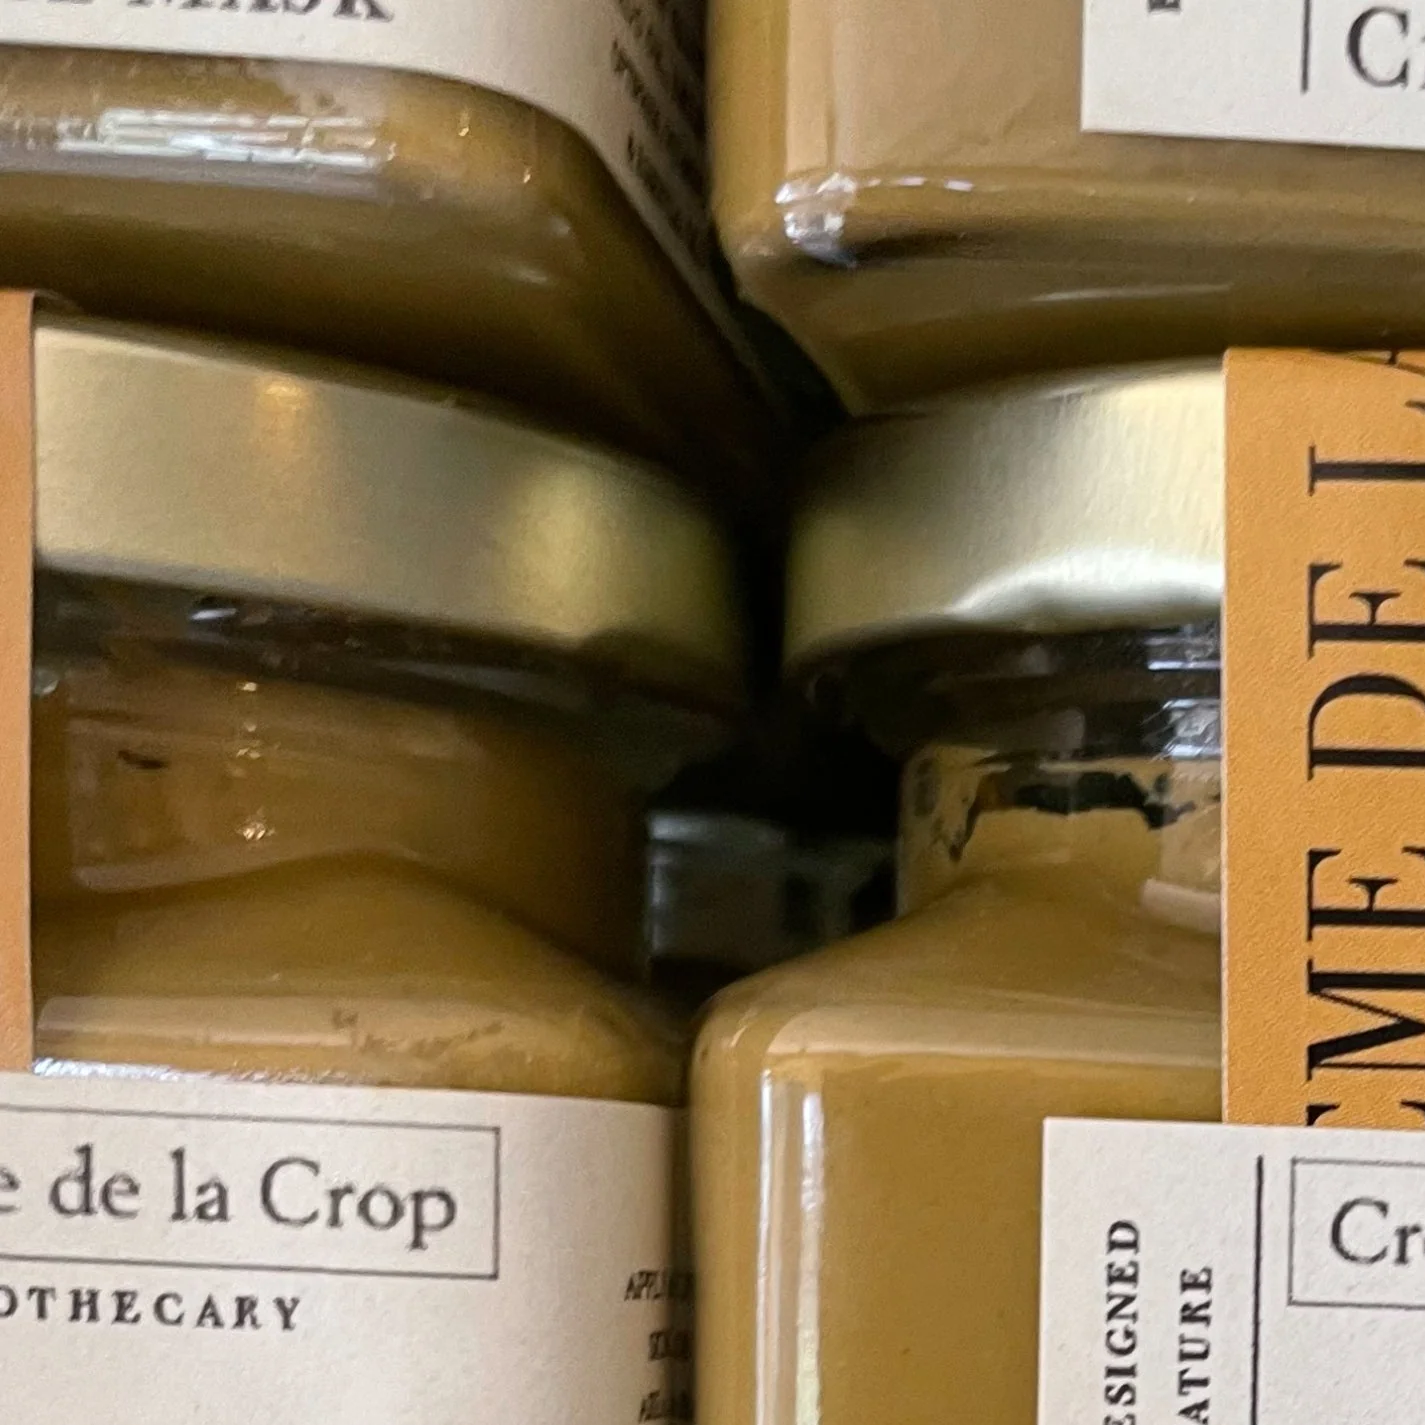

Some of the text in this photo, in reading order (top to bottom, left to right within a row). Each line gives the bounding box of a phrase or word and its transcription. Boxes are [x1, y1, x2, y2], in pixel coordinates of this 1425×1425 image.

[50, 1142, 142, 1219] de
[169, 1145, 231, 1223] la
[260, 1156, 457, 1251] Crop
